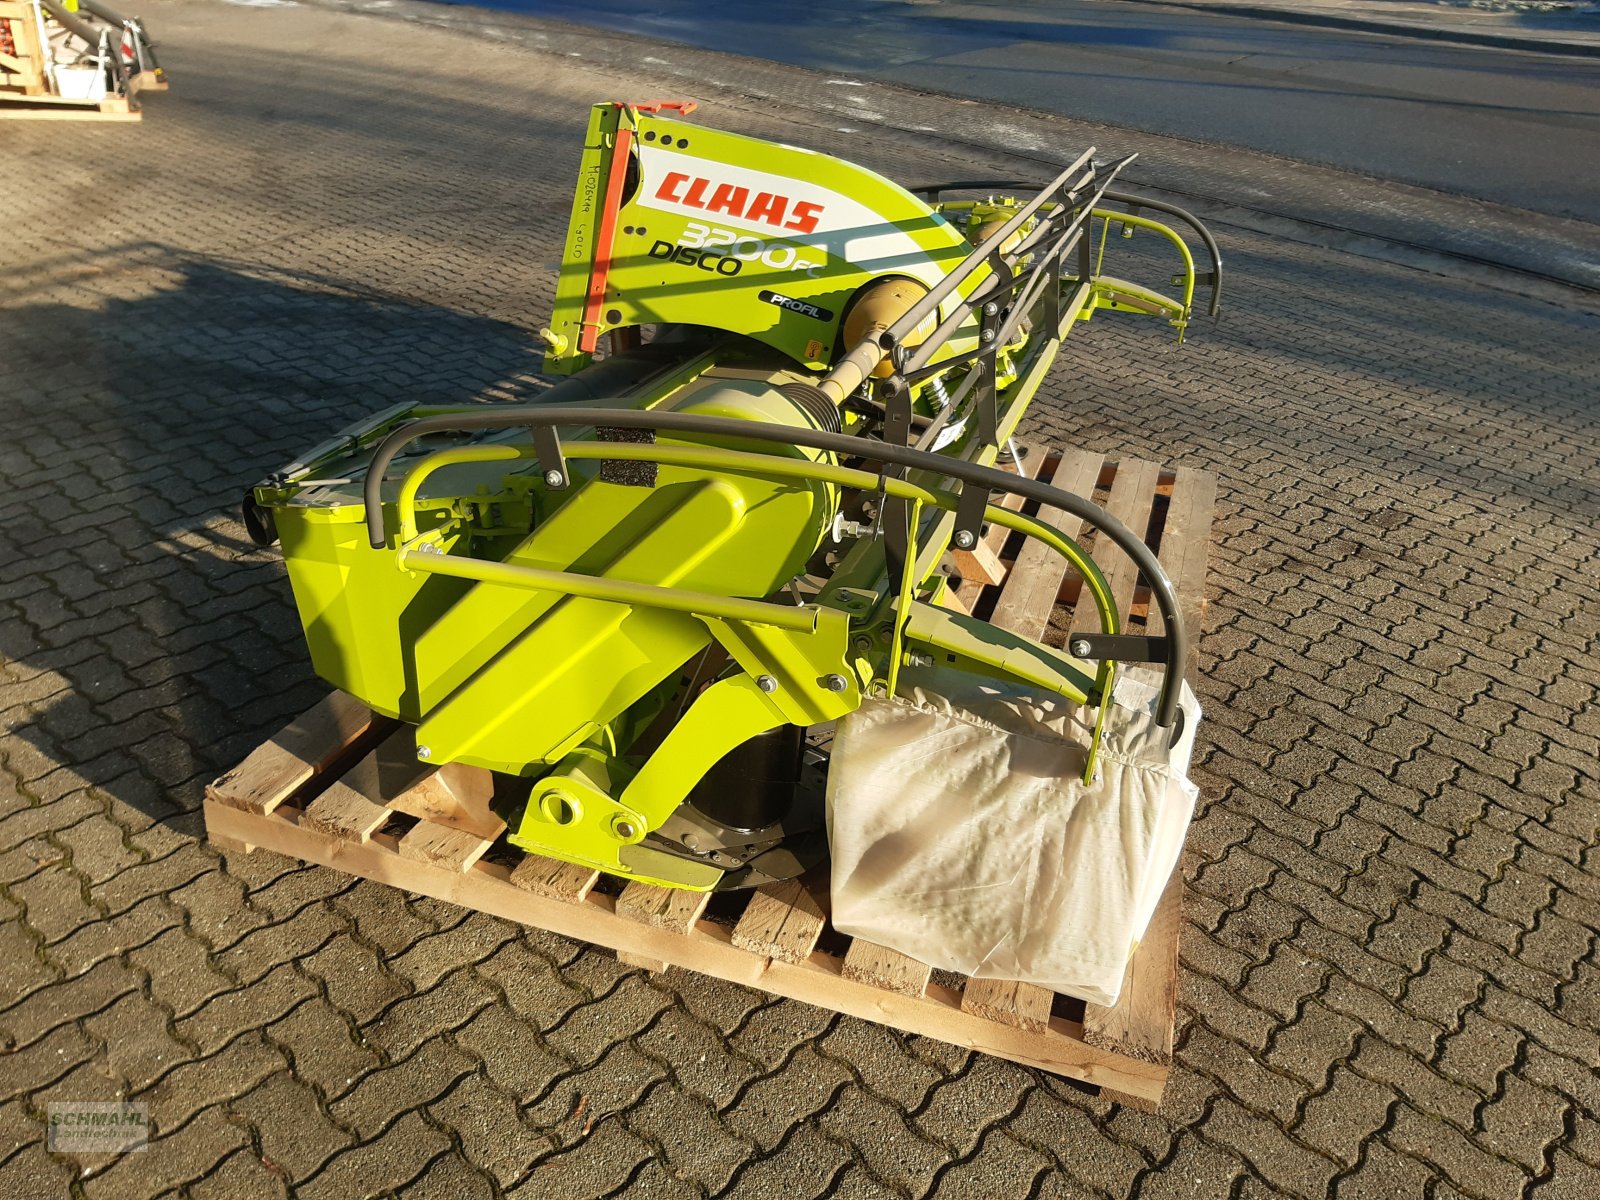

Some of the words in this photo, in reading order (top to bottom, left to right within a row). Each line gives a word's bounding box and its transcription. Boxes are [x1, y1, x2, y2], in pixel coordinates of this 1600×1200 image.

[655, 171, 825, 234] CLAAS
[648, 240, 743, 277] DISCO
[770, 294, 820, 318] PROFIL
